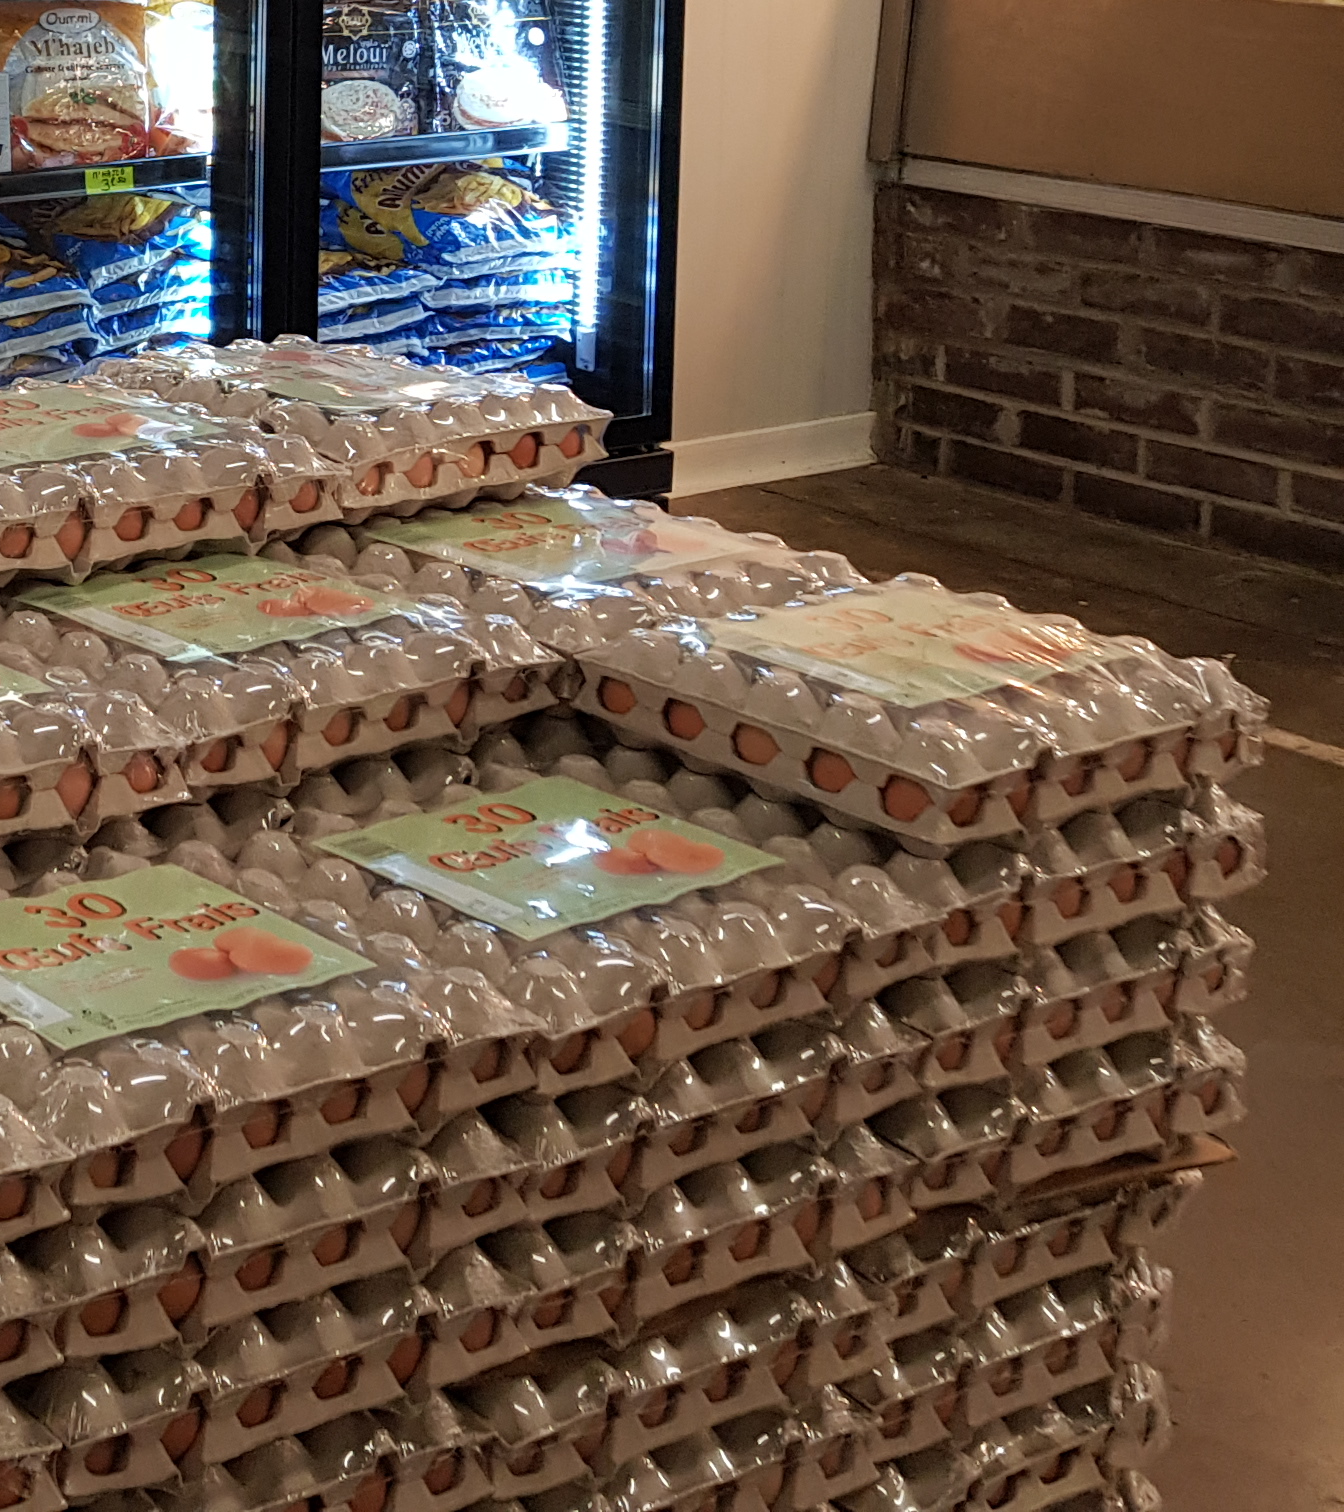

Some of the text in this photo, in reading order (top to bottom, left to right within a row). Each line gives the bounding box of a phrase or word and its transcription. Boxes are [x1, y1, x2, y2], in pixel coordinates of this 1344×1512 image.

[30, 36, 116, 59] M'hajeb
[471, 509, 555, 533] 30
[130, 567, 220, 593] 30
[442, 801, 539, 836] 30
[23, 891, 129, 930] 30
[120, 900, 263, 942] Frais
